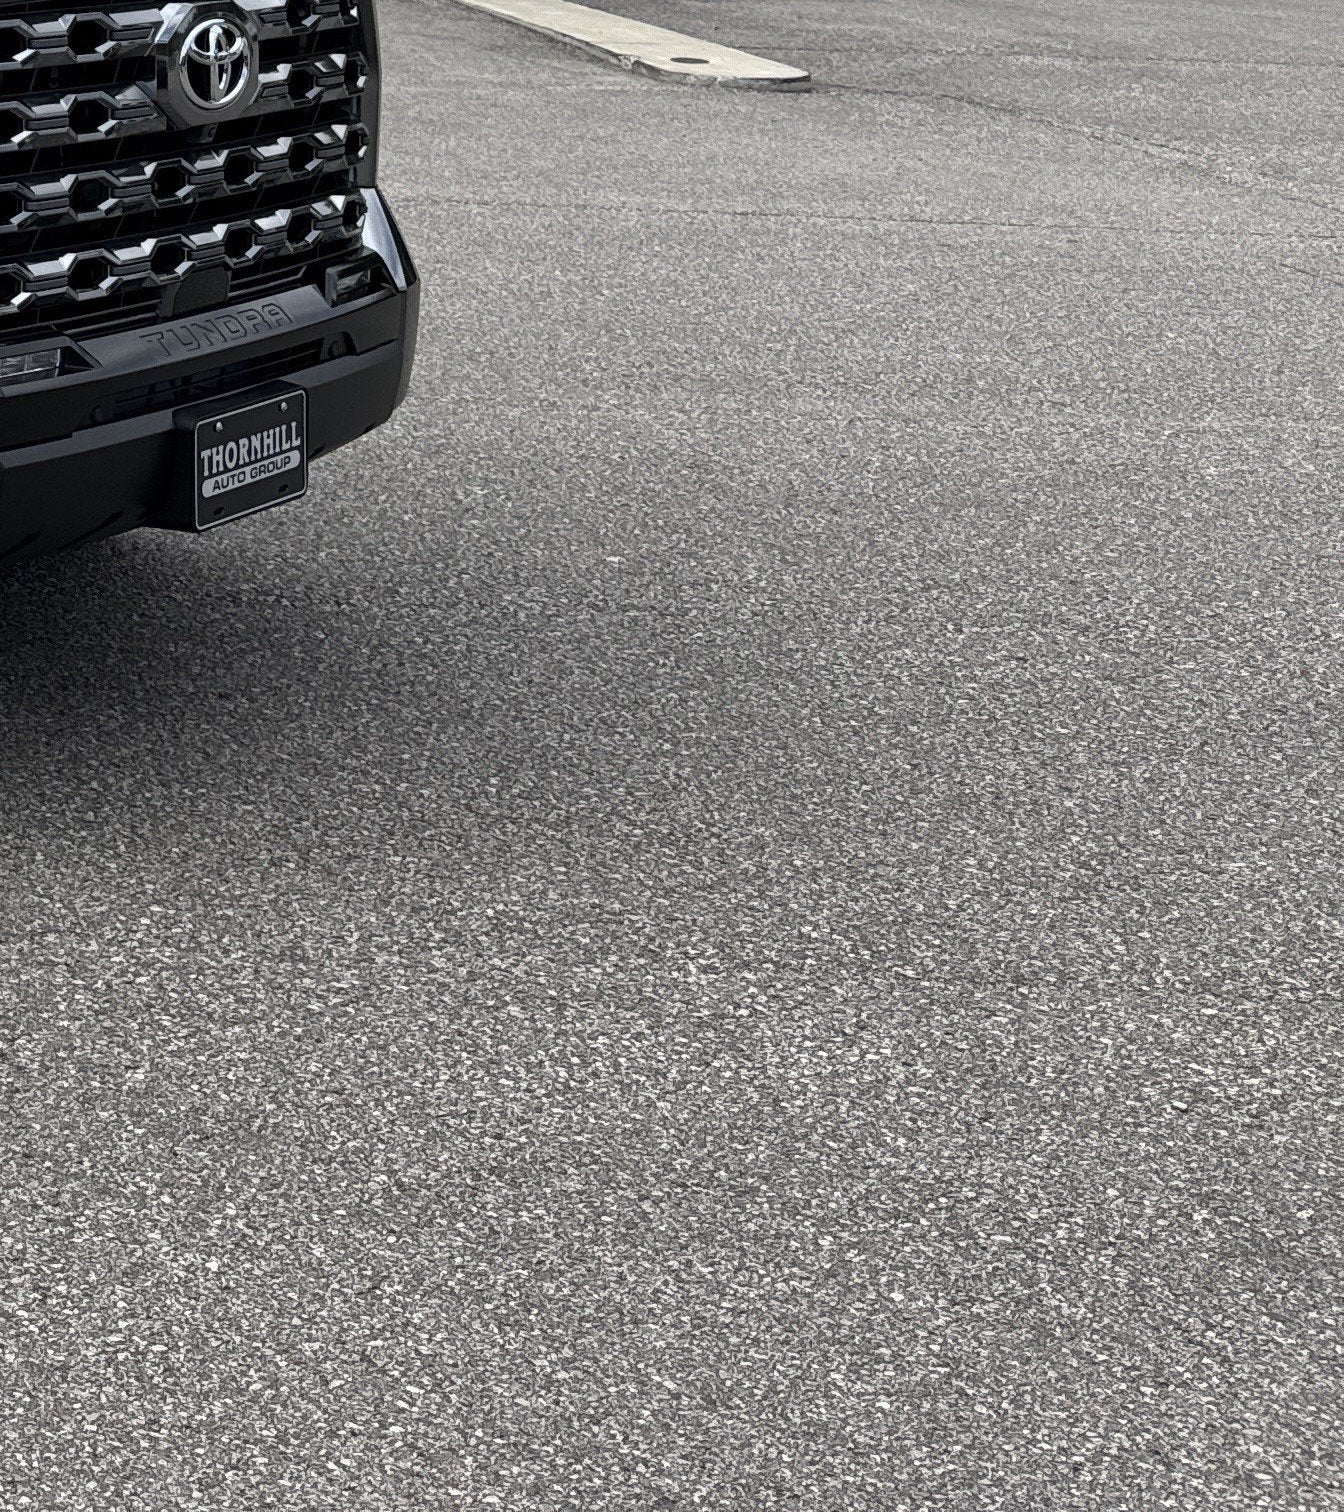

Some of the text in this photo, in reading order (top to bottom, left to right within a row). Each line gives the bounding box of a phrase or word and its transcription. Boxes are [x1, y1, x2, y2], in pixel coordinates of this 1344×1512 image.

[138, 302, 294, 358] TUNDRA
[200, 420, 301, 477] THORNHILL
[211, 455, 291, 493] AUTO GROUP
